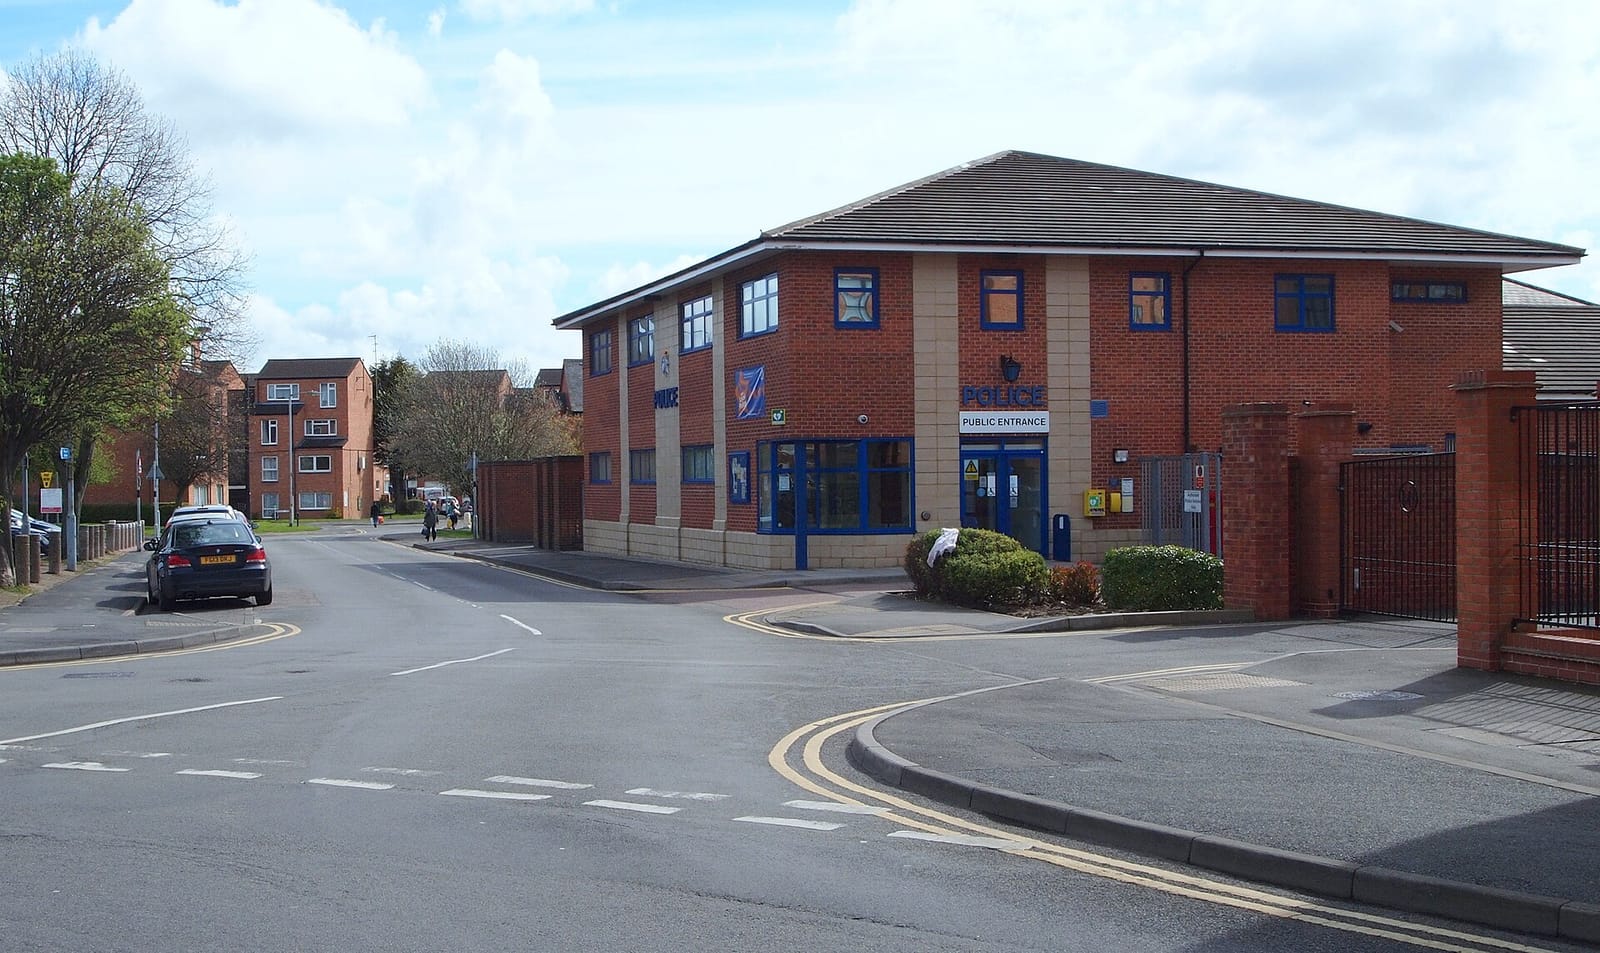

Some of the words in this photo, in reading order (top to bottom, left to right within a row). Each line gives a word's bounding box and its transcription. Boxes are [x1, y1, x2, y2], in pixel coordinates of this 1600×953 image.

[655, 386, 678, 409] POLICE
[962, 385, 1046, 406] POLICE
[962, 418, 996, 426] PUBLIC
[997, 418, 1046, 426] ENTRANCE
